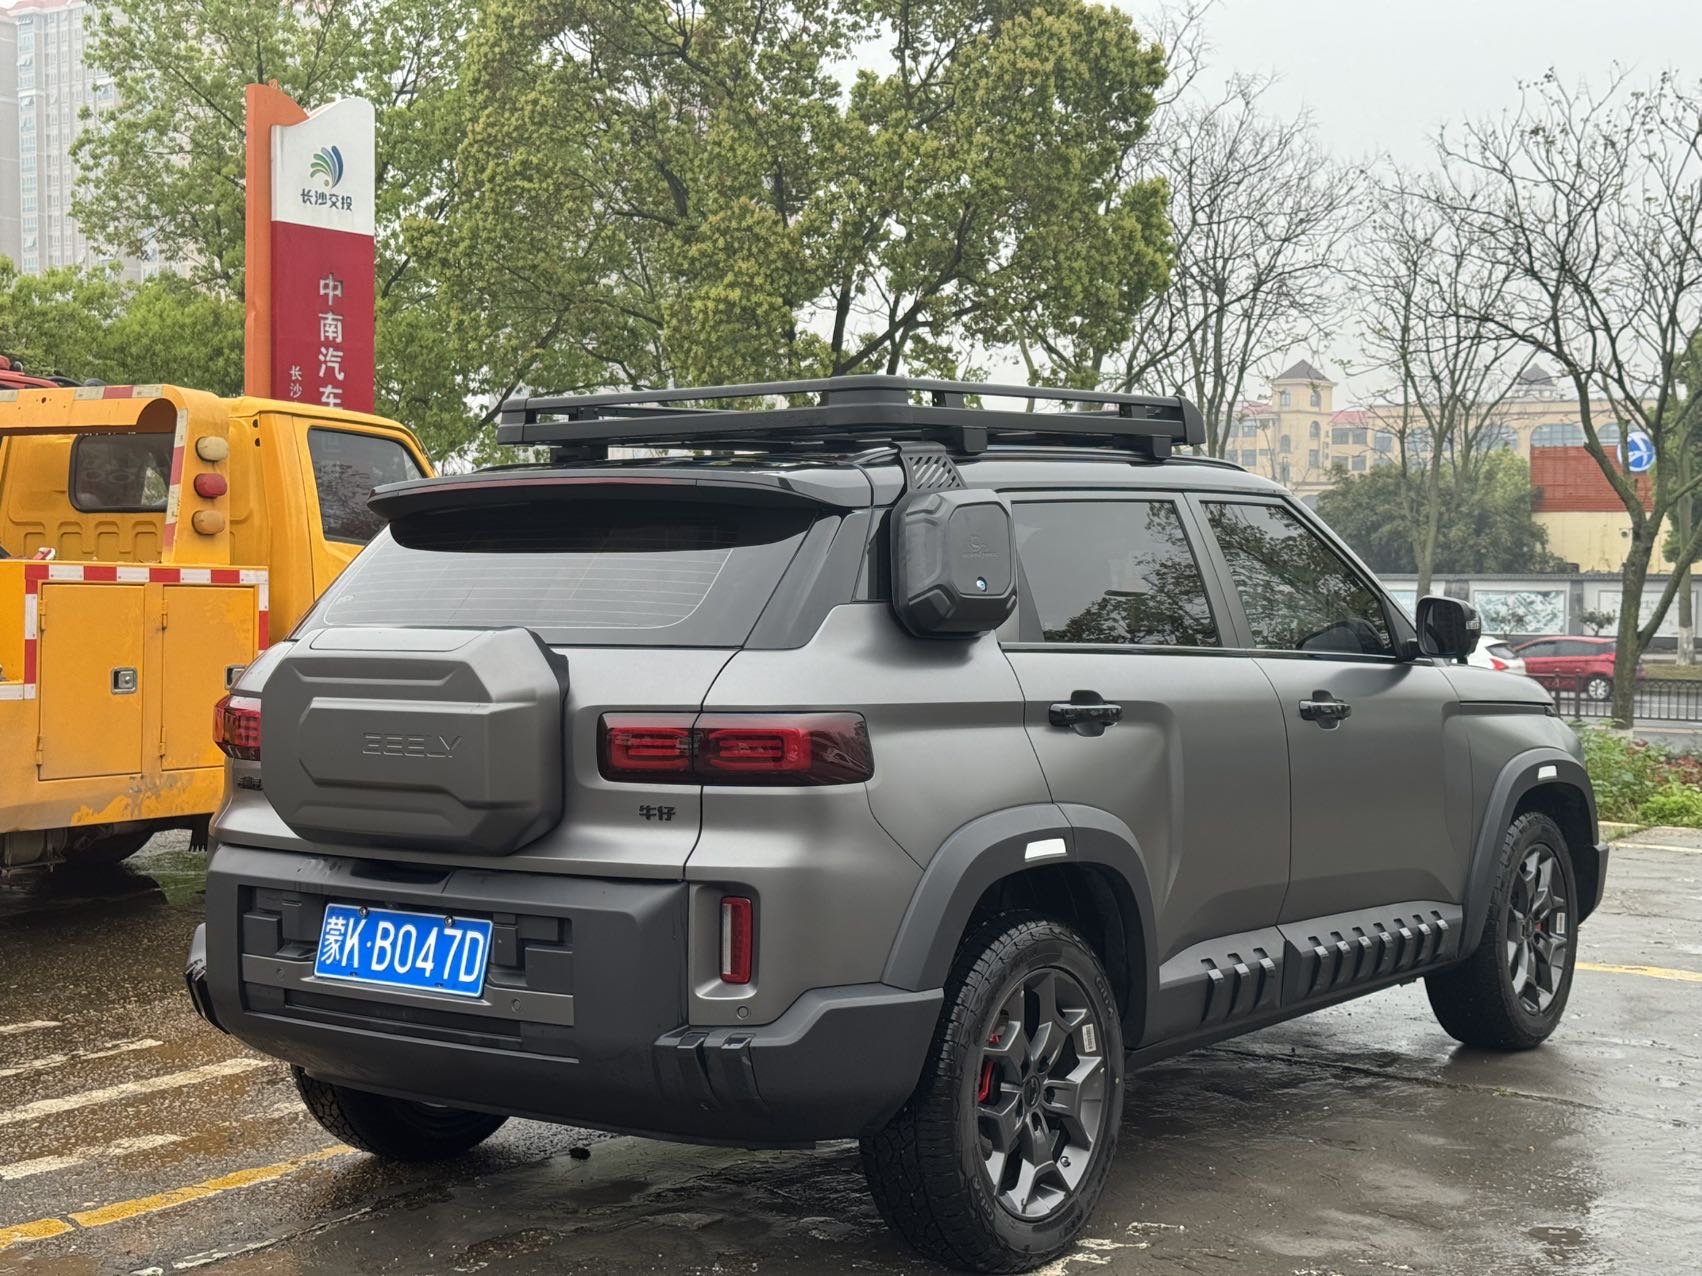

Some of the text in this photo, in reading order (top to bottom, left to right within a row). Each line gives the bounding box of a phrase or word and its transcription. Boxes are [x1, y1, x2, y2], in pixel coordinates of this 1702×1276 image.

[300, 188, 352, 211] 长沙交投
[318, 273, 344, 408] 中南汽车
[362, 733, 463, 758] GEELY
[638, 804, 676, 821] 牛仔
